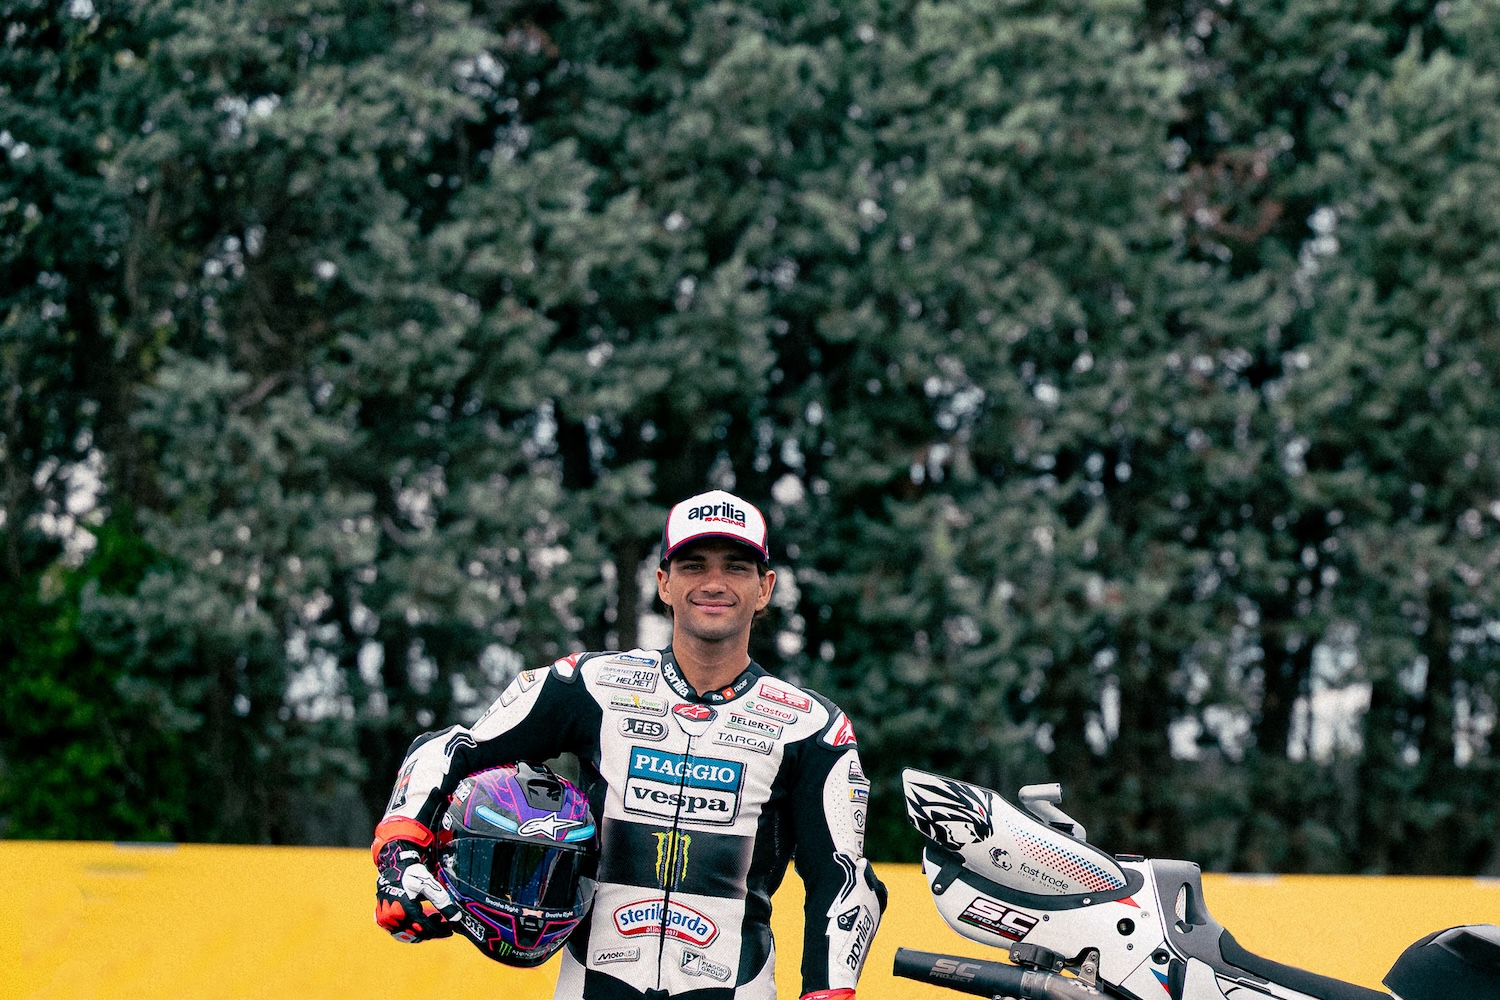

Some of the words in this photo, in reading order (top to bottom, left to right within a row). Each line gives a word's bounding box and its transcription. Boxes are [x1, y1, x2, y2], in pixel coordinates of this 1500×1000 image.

[687, 501, 746, 523] aprilia
[704, 517, 746, 529] RACING
[616, 676, 652, 688] HELMET
[664, 662, 690, 698] aprilia
[733, 679, 748, 693] racer
[755, 703, 792, 720] Castrol
[634, 721, 661, 737] FES
[718, 732, 767, 750] TARGA
[634, 754, 735, 783] PIAGGIO
[632, 786, 729, 813] vespa
[1020, 862, 1040, 878] fast
[1041, 872, 1069, 891] trade
[620, 904, 708, 936] sterilgarda
[963, 911, 1027, 936] PROJECT
[966, 898, 1040, 933] SC
[846, 914, 872, 971] aprilia
[928, 971, 975, 984] PROJECT
[931, 958, 982, 979] SC
